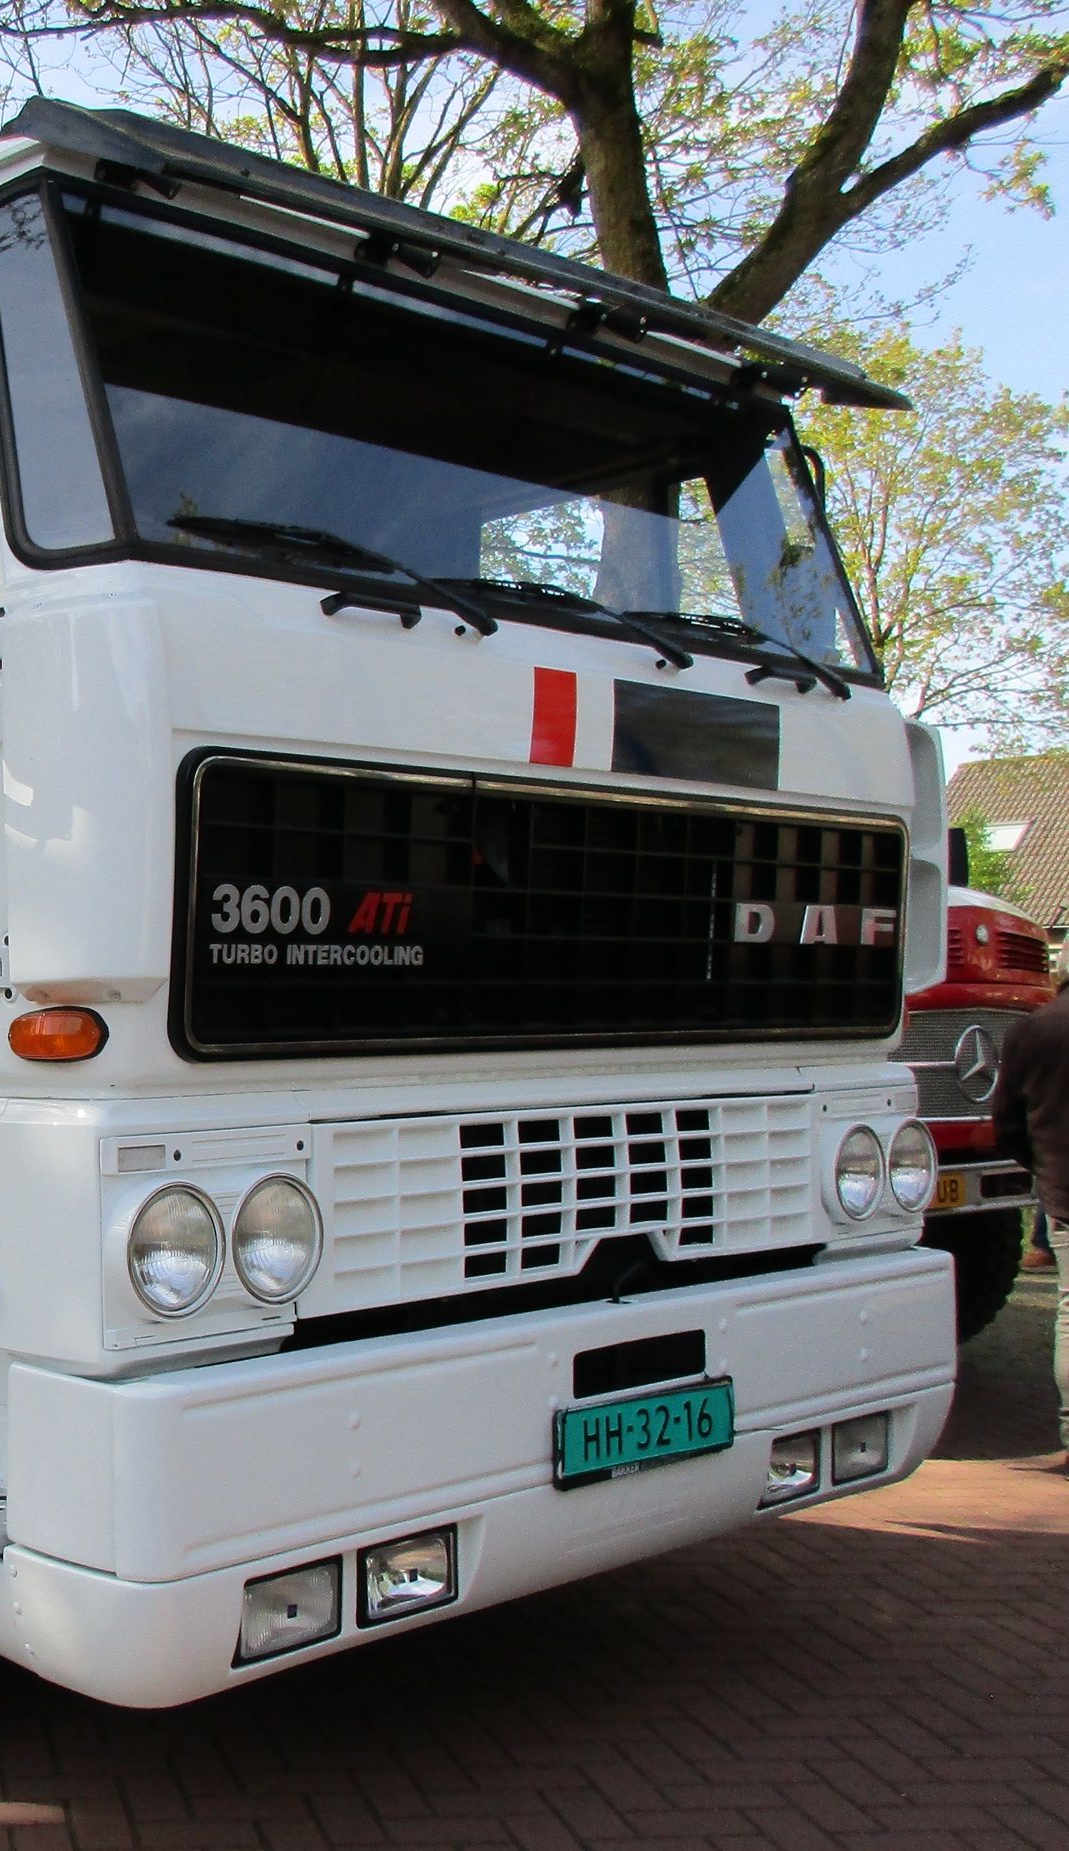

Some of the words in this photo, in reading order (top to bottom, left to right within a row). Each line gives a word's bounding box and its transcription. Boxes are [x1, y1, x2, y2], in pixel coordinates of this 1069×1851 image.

[211, 883, 331, 935] 3600
[348, 892, 413, 935] ATi
[733, 902, 897, 946] DAF
[209, 943, 278, 965] TURBO
[286, 944, 424, 966] INTERCOOLING
[583, 1397, 713, 1462] HH-32-16
